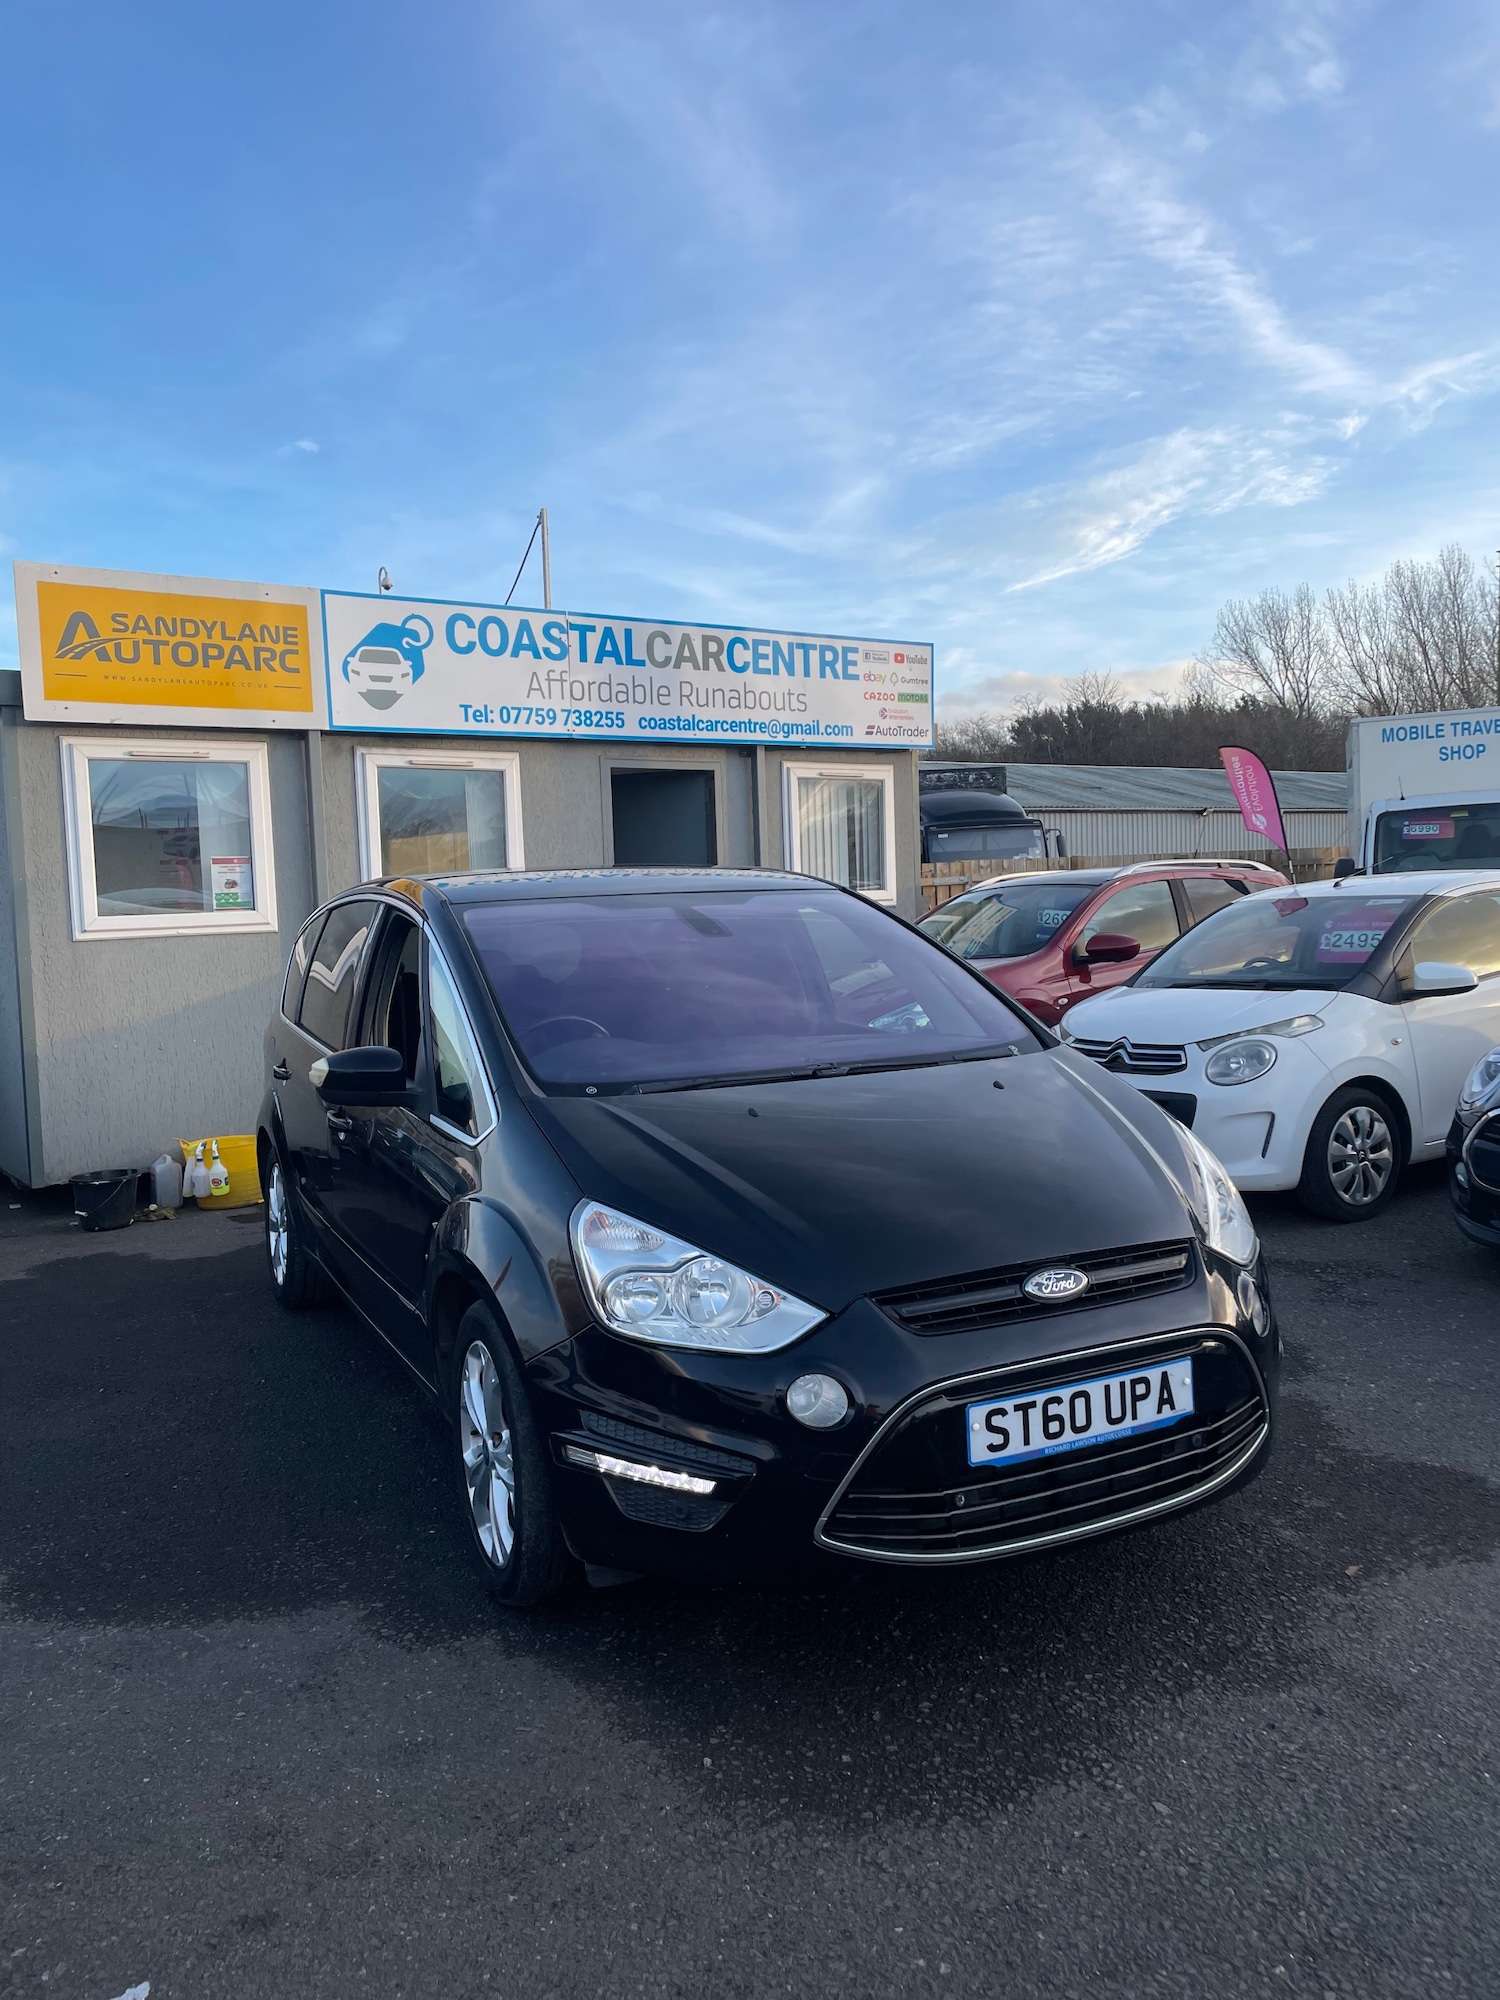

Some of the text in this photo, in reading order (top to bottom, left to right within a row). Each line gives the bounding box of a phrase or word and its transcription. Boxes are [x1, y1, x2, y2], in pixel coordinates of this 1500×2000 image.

[111, 612, 299, 646] SANDYLANE
[55, 610, 301, 674] AUTOPARC
[445, 612, 860, 682] COASTALCARCENTRE
[905, 654, 928, 665] YouTube
[526, 669, 808, 713] Affordable Runabouts
[900, 676, 929, 685] Gumtree
[863, 691, 896, 701] CAZOO
[459, 703, 854, 739] Tel: 07759 738255 coastalcarcentre@gmail.com
[874, 724, 929, 738] AutoTrader
[1381, 723, 1445, 743] MOBILE
[1438, 743, 1487, 762] SHOP
[1041, 1271, 1077, 1293] Ford
[984, 1370, 1177, 1454] ST60 UPA
[1044, 1441, 1071, 1456] RICHARD
[1071, 1436, 1097, 1449] LAWSON
